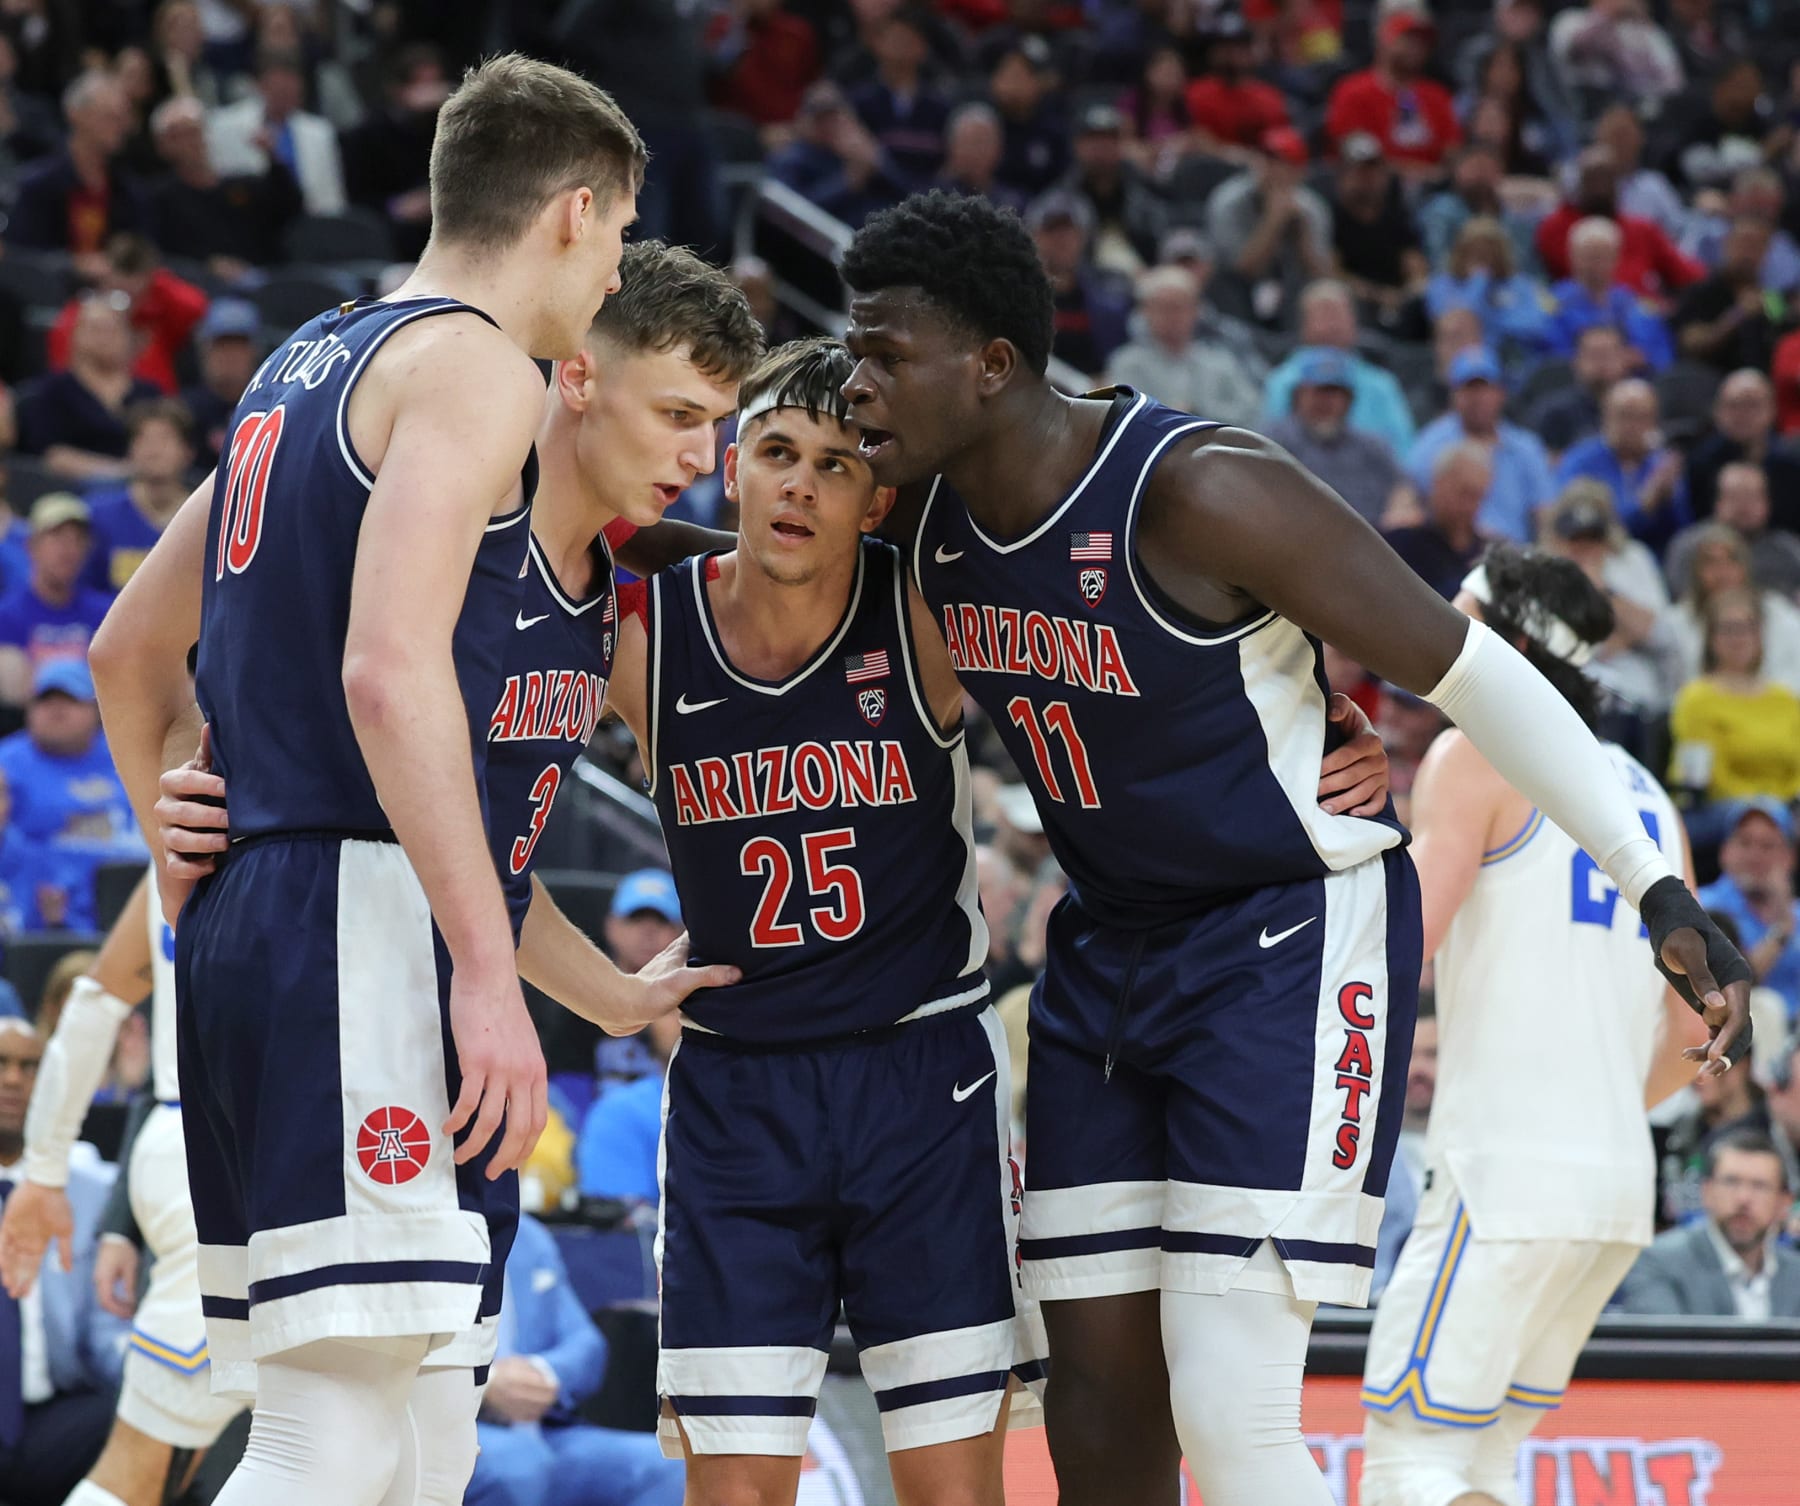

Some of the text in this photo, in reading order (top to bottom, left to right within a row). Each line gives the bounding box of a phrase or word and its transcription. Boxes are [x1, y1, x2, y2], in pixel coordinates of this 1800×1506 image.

[215, 403, 286, 583] 10
[1085, 584, 1099, 599] 12
[943, 603, 1141, 697] ARIZONA
[487, 669, 609, 748] ARIZON
[866, 703, 881, 719] 12
[1006, 695, 1102, 809] 11
[510, 763, 561, 875] 3
[669, 740, 917, 826] ARIZONA
[740, 827, 866, 948] 25
[1332, 980, 1375, 1170] CATS
[377, 1129, 409, 1161] A
